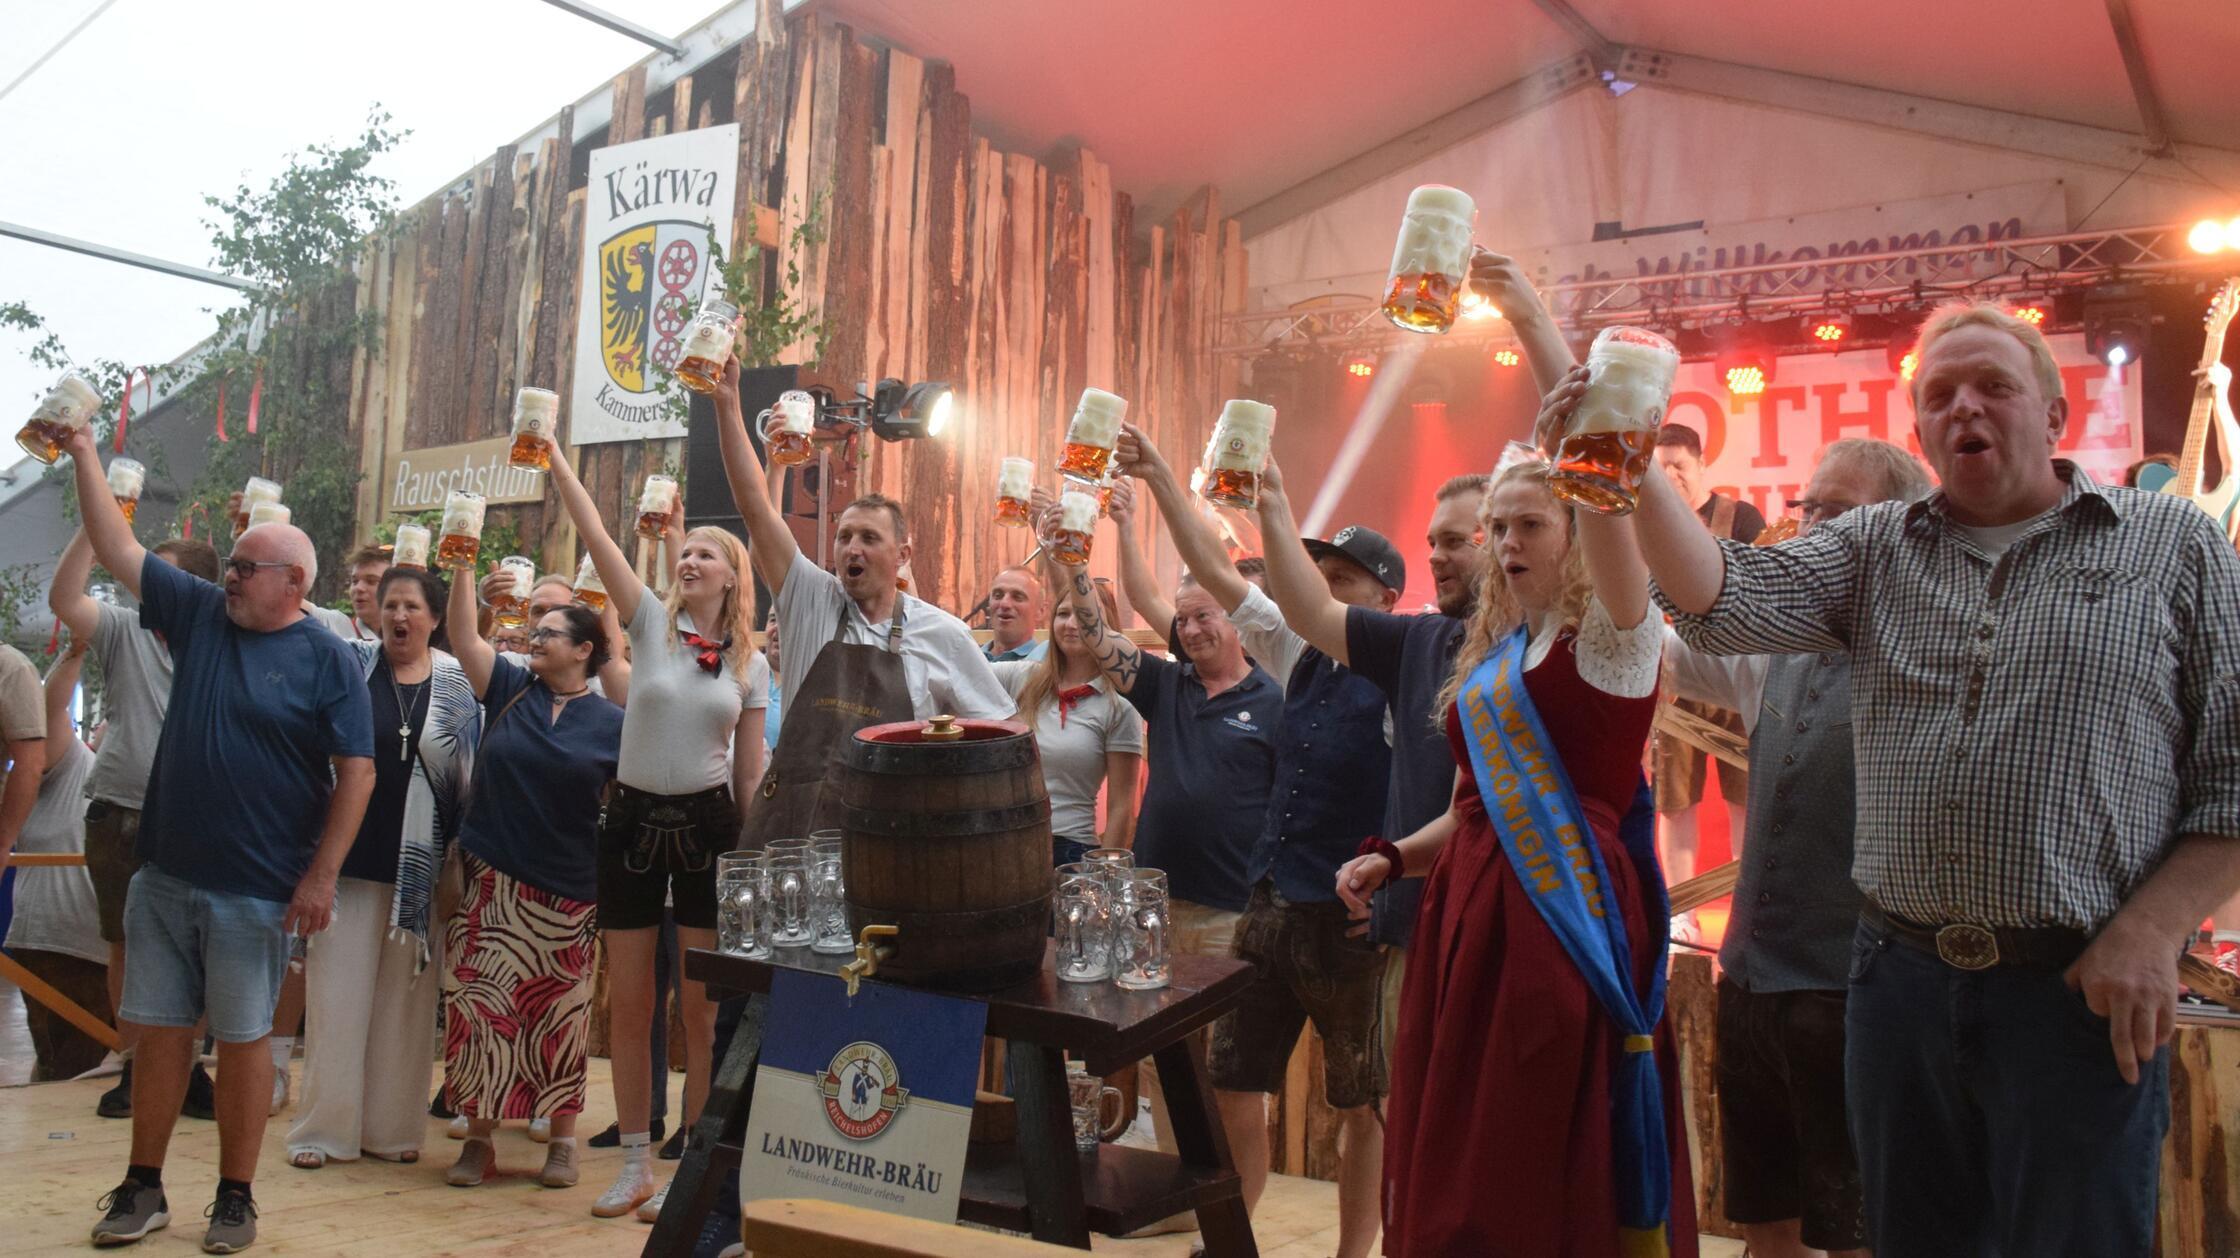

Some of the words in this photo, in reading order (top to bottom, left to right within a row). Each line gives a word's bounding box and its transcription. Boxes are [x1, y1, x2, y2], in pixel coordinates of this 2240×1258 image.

[604, 160, 718, 222] Kärwa
[1636, 217, 2021, 297] Willkommen
[828, 1101, 889, 1135] REICHELSHOFEN
[761, 1132, 942, 1194] LANDWEHR-BRÄU
[831, 1176, 873, 1196] Bierkultur
[873, 1187, 906, 1203] erleben
